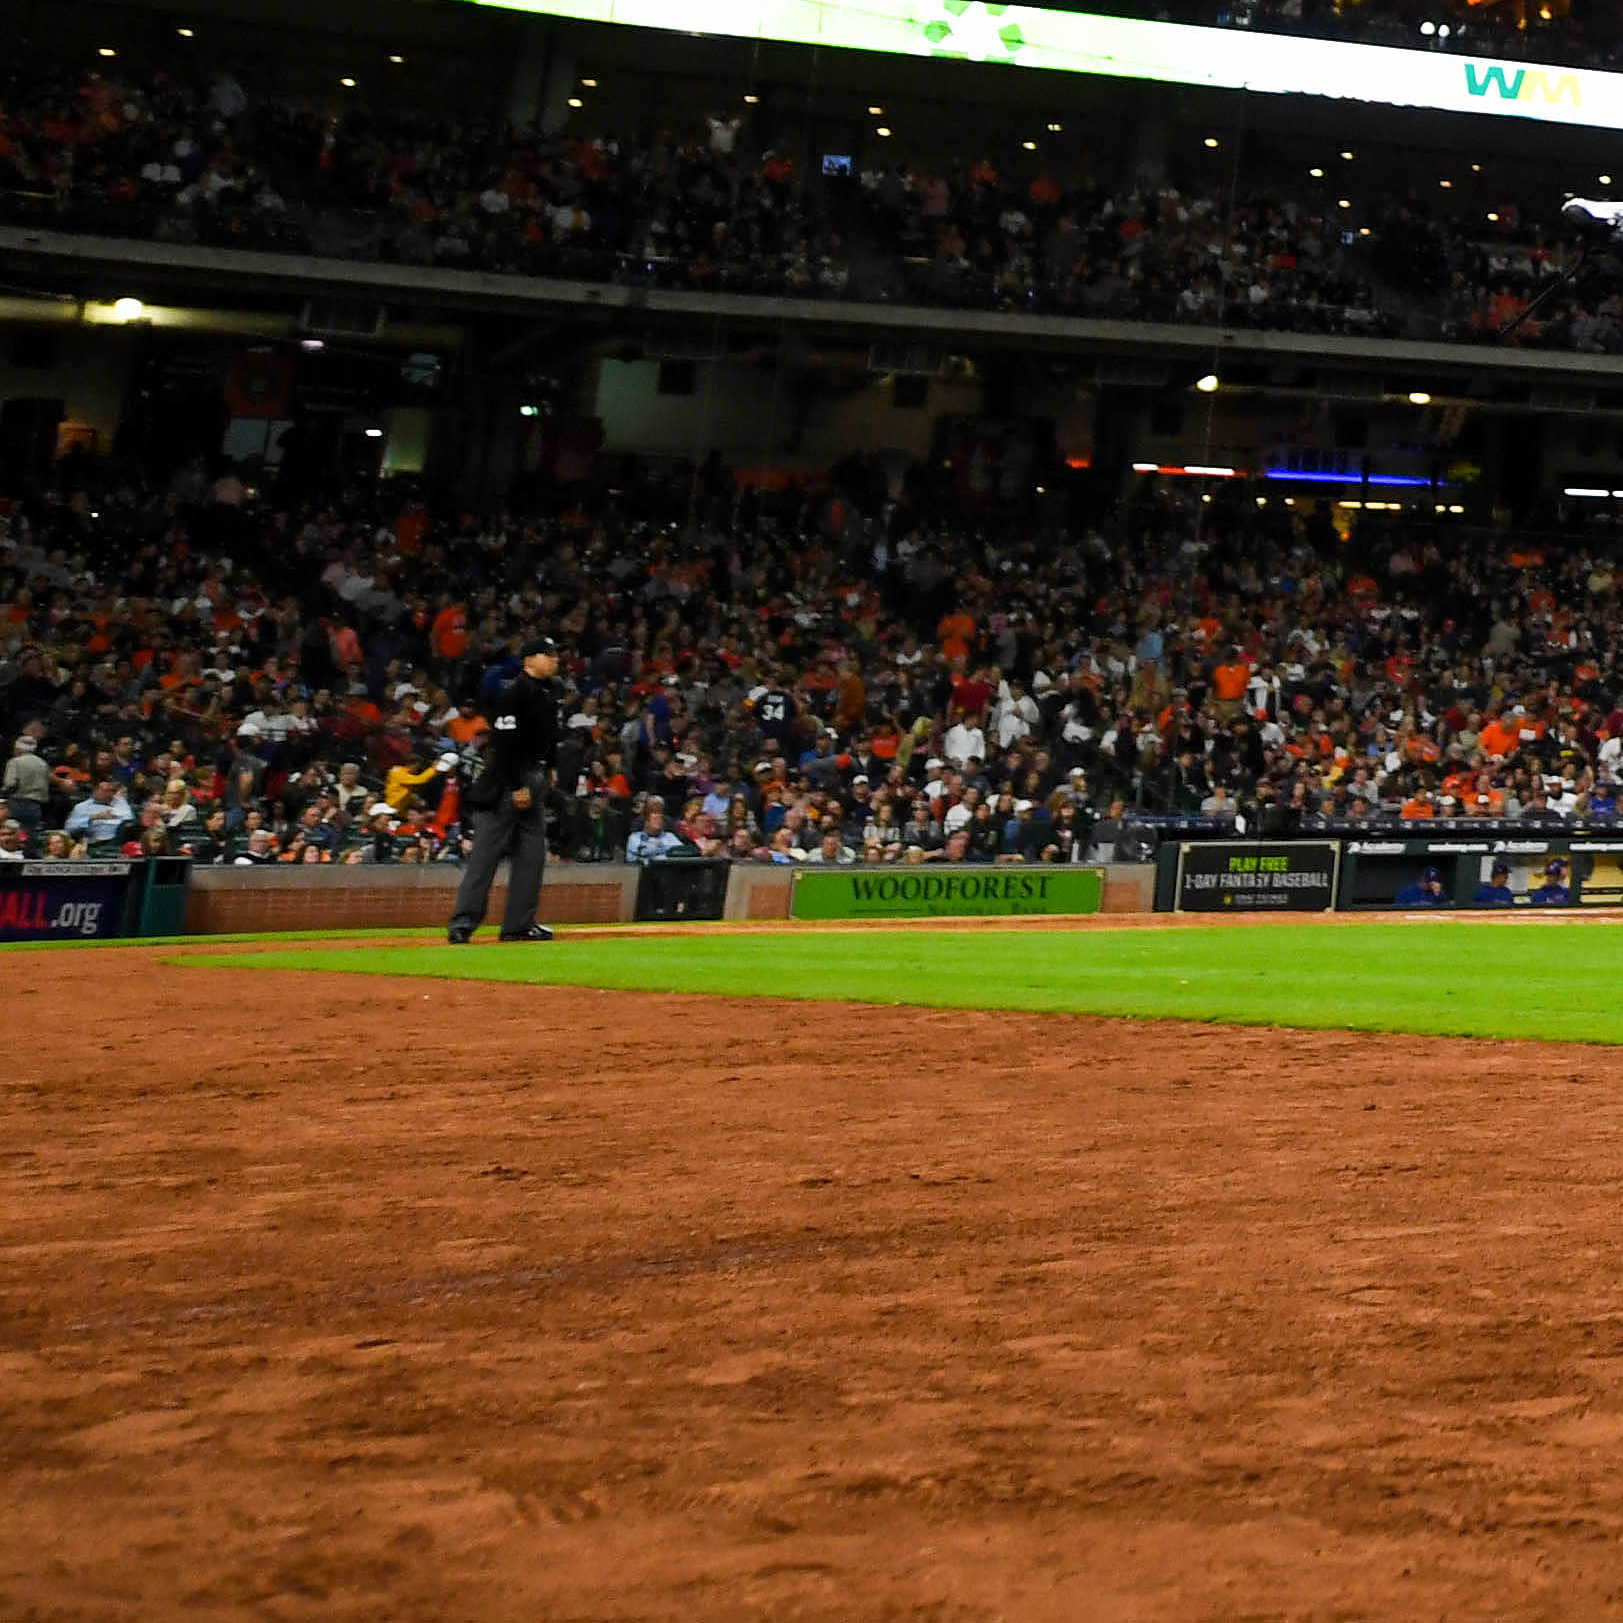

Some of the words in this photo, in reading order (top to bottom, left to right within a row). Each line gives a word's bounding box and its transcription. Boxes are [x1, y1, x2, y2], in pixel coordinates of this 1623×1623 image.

[1465, 63, 1582, 107] WM
[1228, 856, 1258, 872] PLAY
[1260, 856, 1289, 872] FREE
[851, 876, 1052, 900] WOODFOREST
[1185, 873, 1218, 889] 1-DAY
[1220, 873, 1269, 889] FANTASY
[1272, 872, 1328, 888] BASEBALL
[0, 889, 104, 936] ALL.org
